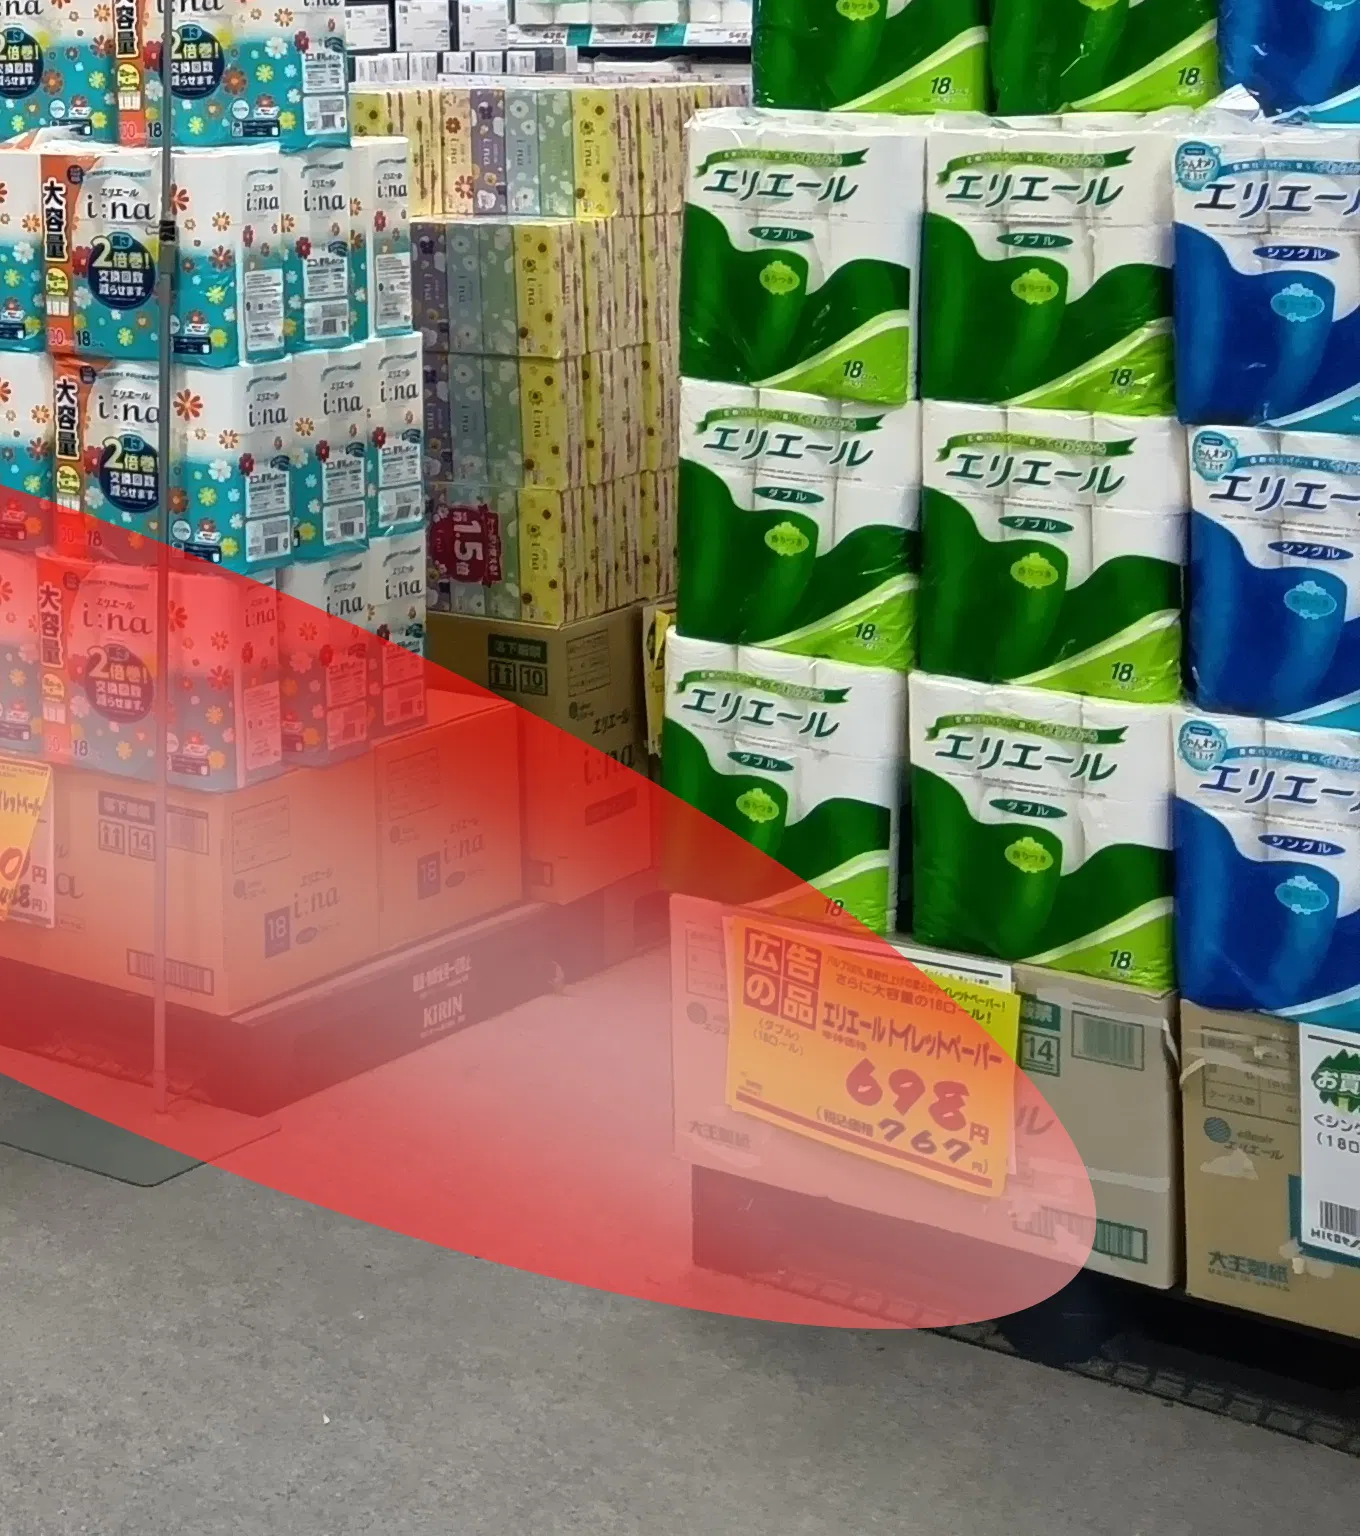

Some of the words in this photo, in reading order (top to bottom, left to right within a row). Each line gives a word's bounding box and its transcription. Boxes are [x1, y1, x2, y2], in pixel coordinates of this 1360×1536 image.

[929, 74, 952, 96] 18
[1176, 66, 1201, 87] 18
[703, 167, 859, 204] エリエール
[946, 172, 1124, 207] エリエール
[43, 179, 67, 262] 大容量
[758, 226, 799, 241] ダブル
[1012, 234, 1057, 247] ダブル
[1268, 247, 1326, 259] シングル
[842, 359, 864, 380] 18
[1107, 368, 1132, 387] 18
[703, 425, 874, 467] エリエール
[946, 452, 1125, 494] エリエール
[767, 488, 809, 503] ダブル
[1011, 518, 1058, 533] ダブル
[1281, 542, 1341, 559] シングル
[40, 584, 64, 667] 大容量
[853, 622, 876, 642] 18
[522, 669, 544, 685] 10
[1110, 662, 1134, 683] 18
[682, 687, 840, 739] エリエール
[742, 754, 778, 769] ダブル
[935, 732, 1118, 781] エリエール
[1004, 802, 1051, 817] ダブル
[1272, 838, 1333, 856] シングル
[822, 897, 844, 917] 18
[1107, 948, 1133, 970] 18
[423, 994, 463, 1028] KIRIN
[1024, 1037, 1055, 1065] 14
